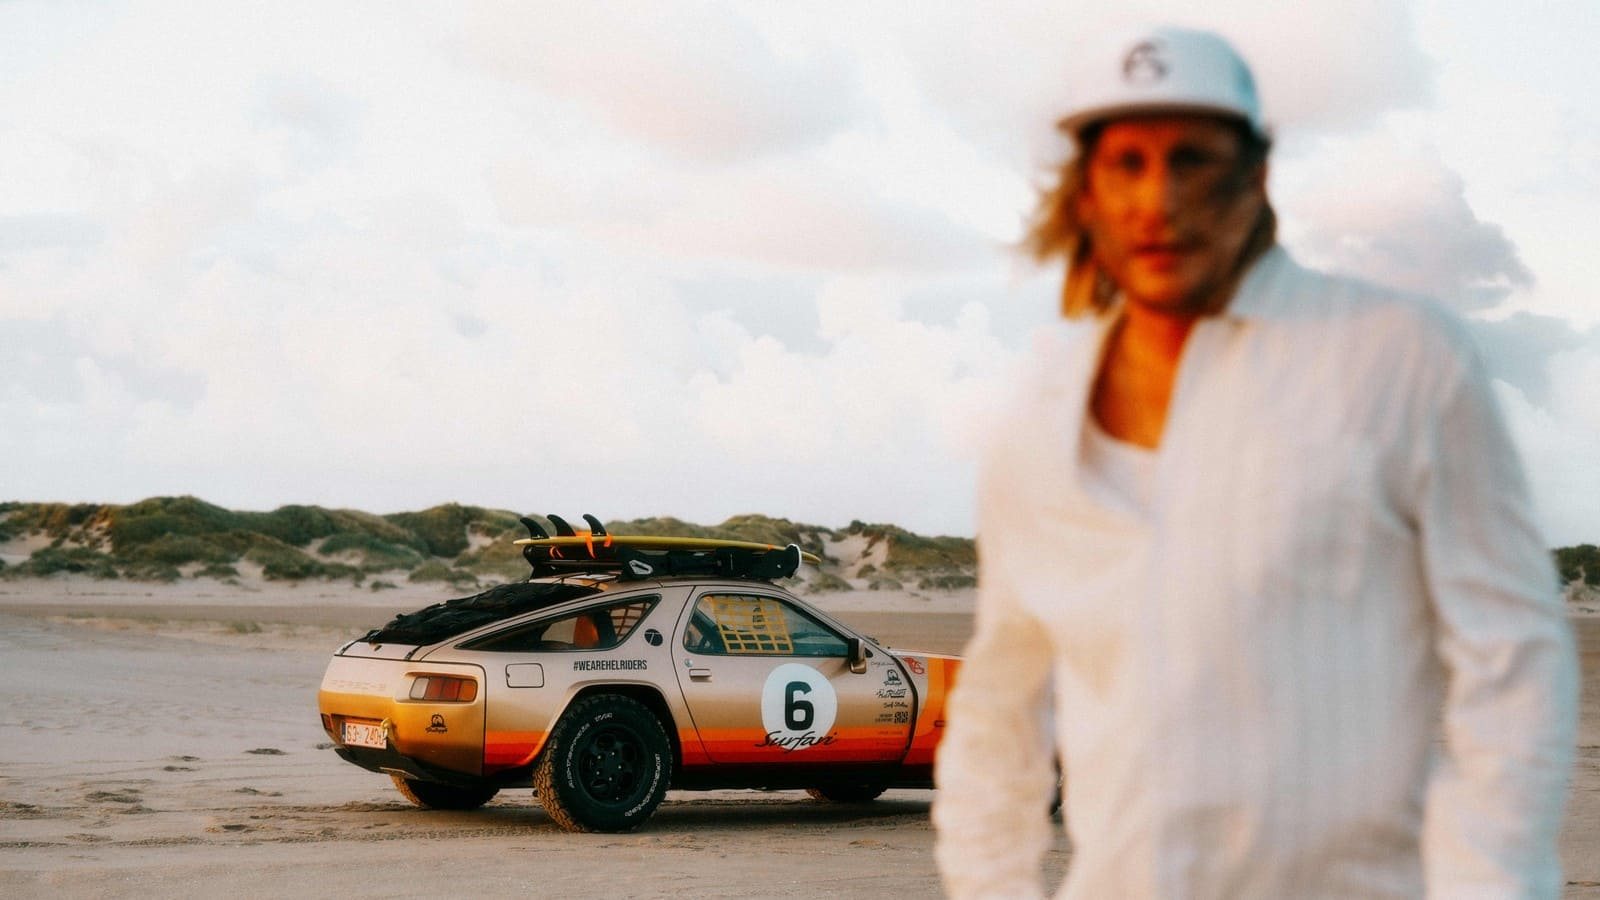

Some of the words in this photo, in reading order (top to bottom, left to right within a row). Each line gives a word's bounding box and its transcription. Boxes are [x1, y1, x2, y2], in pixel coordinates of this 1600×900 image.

[573, 660, 648, 671] #WEAREHELRIDERS
[784, 681, 814, 731] 6
[755, 730, 838, 754] Surfari
